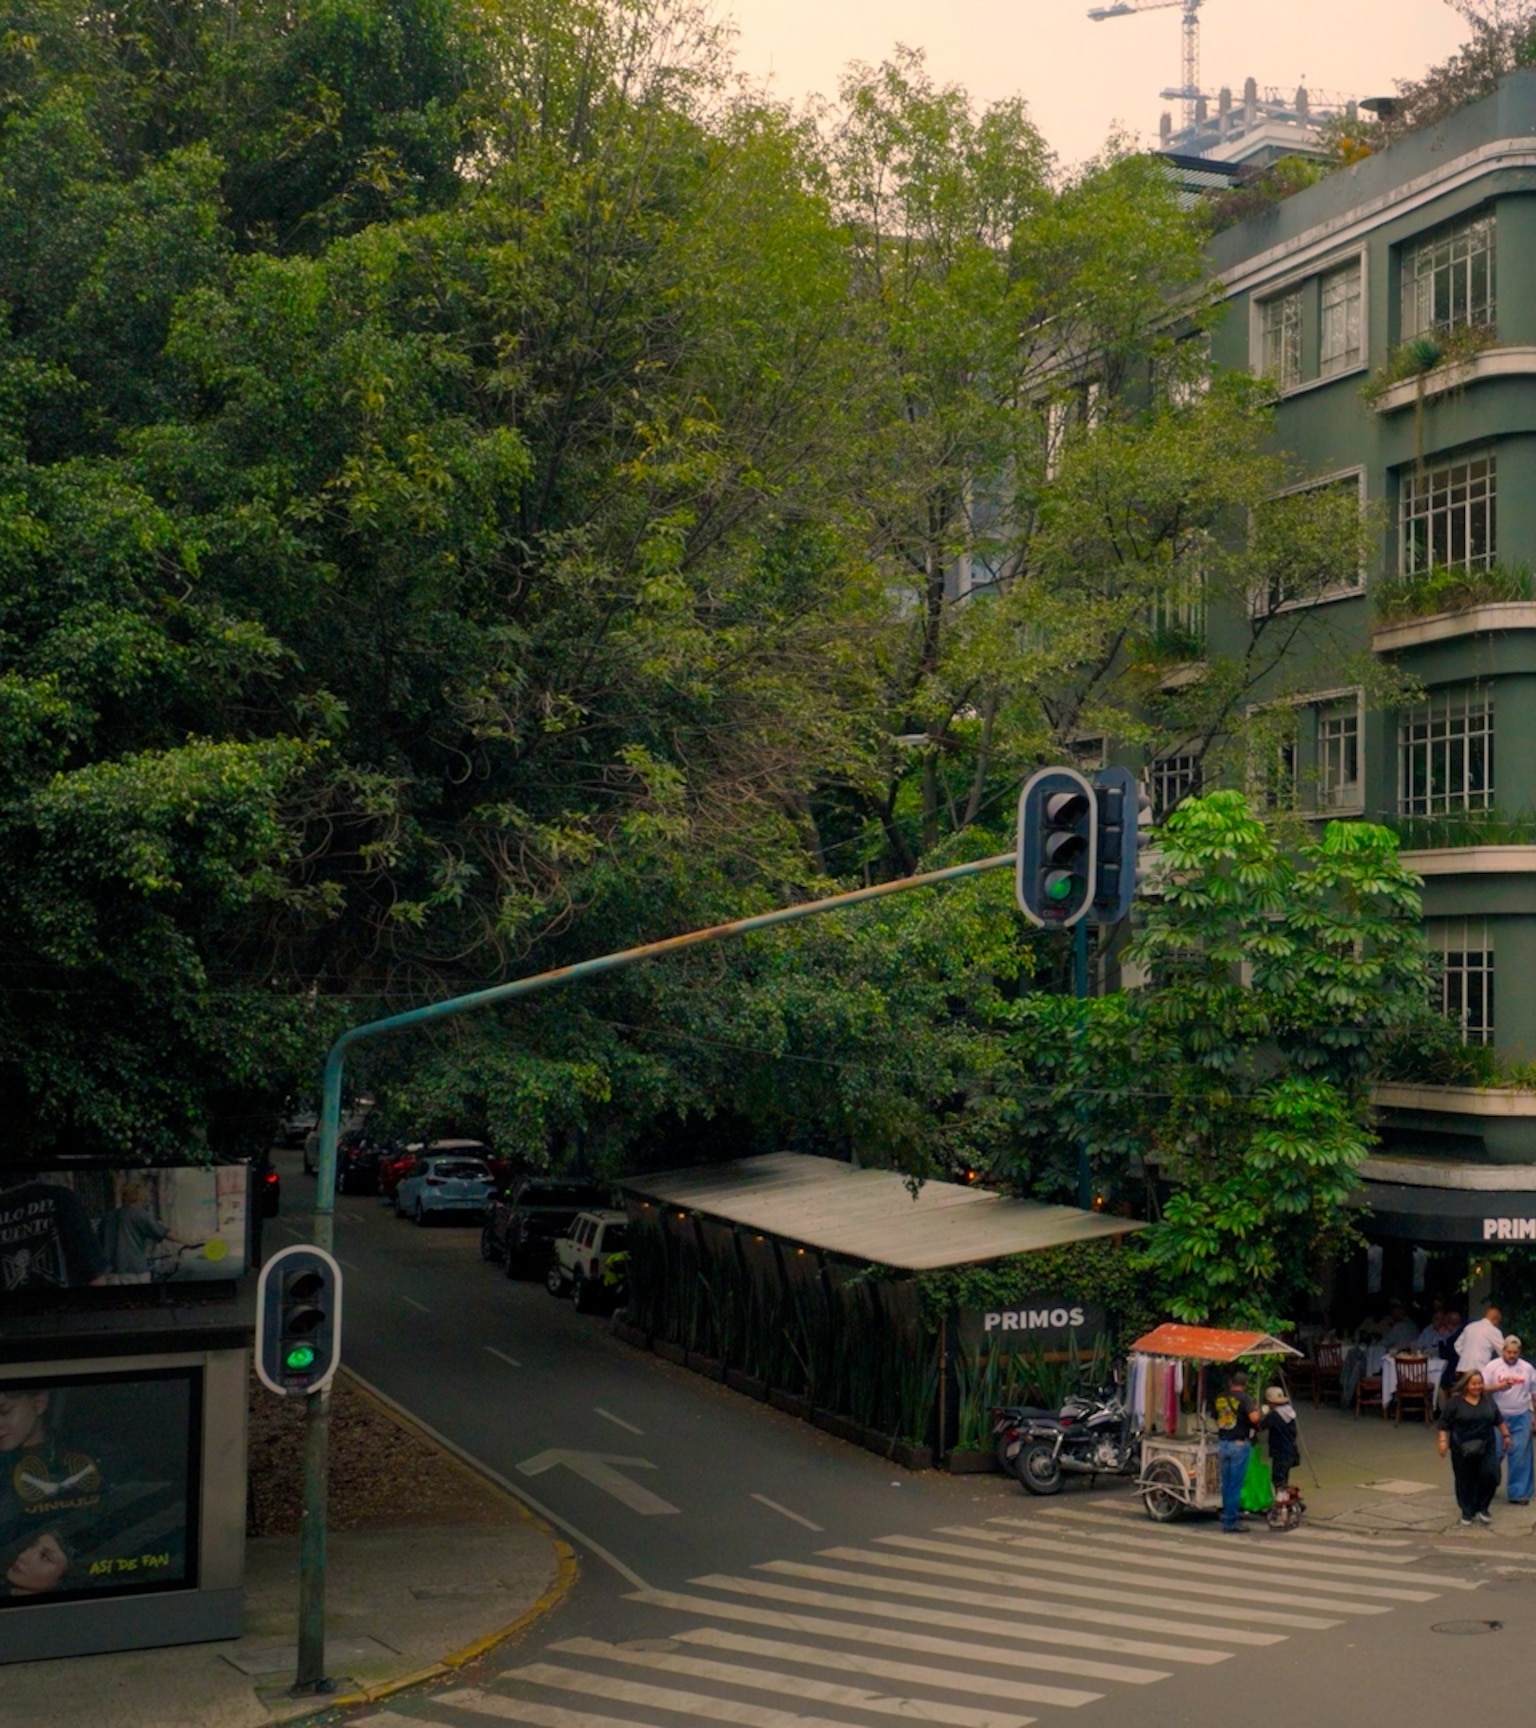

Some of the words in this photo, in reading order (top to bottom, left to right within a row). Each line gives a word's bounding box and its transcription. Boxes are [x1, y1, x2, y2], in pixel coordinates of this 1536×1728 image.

[984, 1307, 1085, 1331] PRIMOS
[116, 1558, 138, 1571] DE
[142, 1552, 169, 1568] FAN
